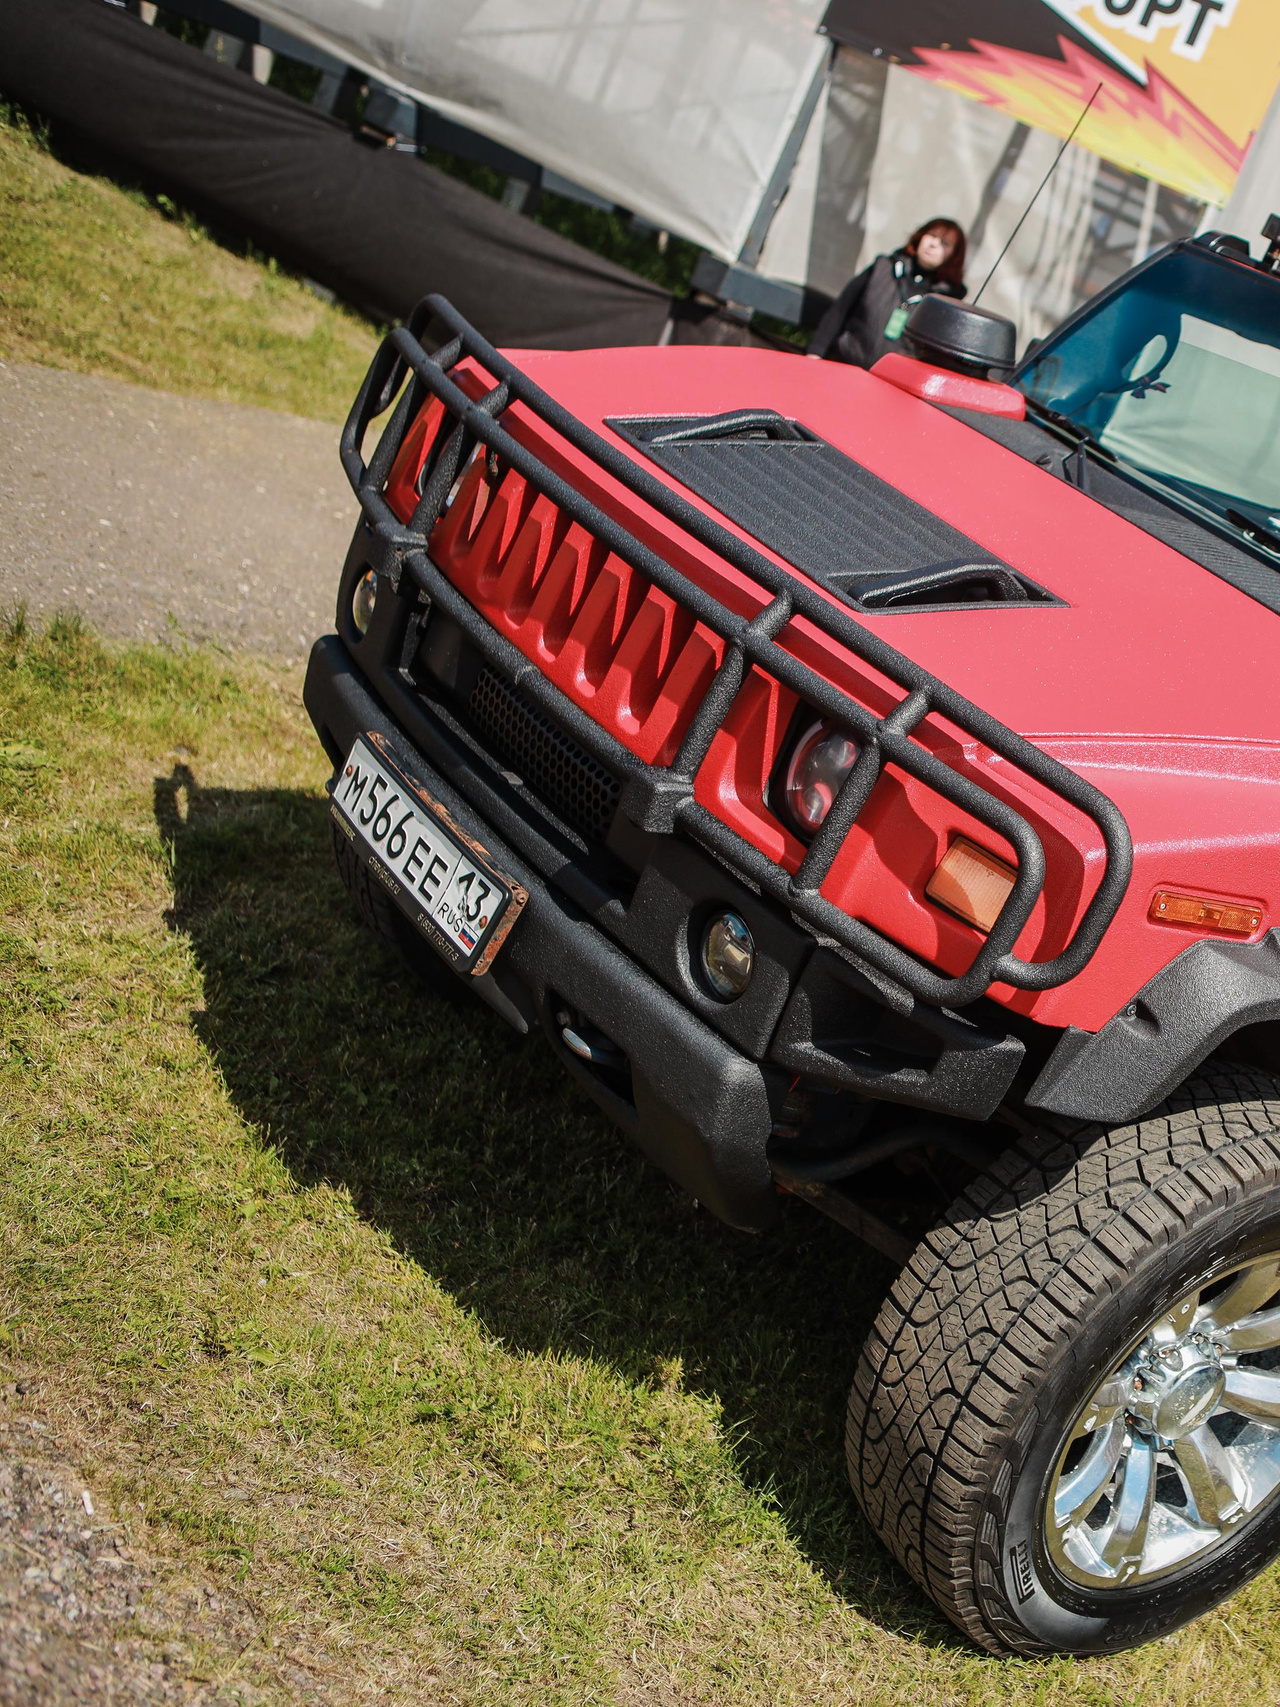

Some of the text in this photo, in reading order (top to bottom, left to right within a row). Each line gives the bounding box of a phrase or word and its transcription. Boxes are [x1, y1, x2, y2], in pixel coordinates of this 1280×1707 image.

[437, 902, 465, 933] RUS
[458, 871, 492, 922] 13
[1010, 1539, 1036, 1606] PIRELLI
